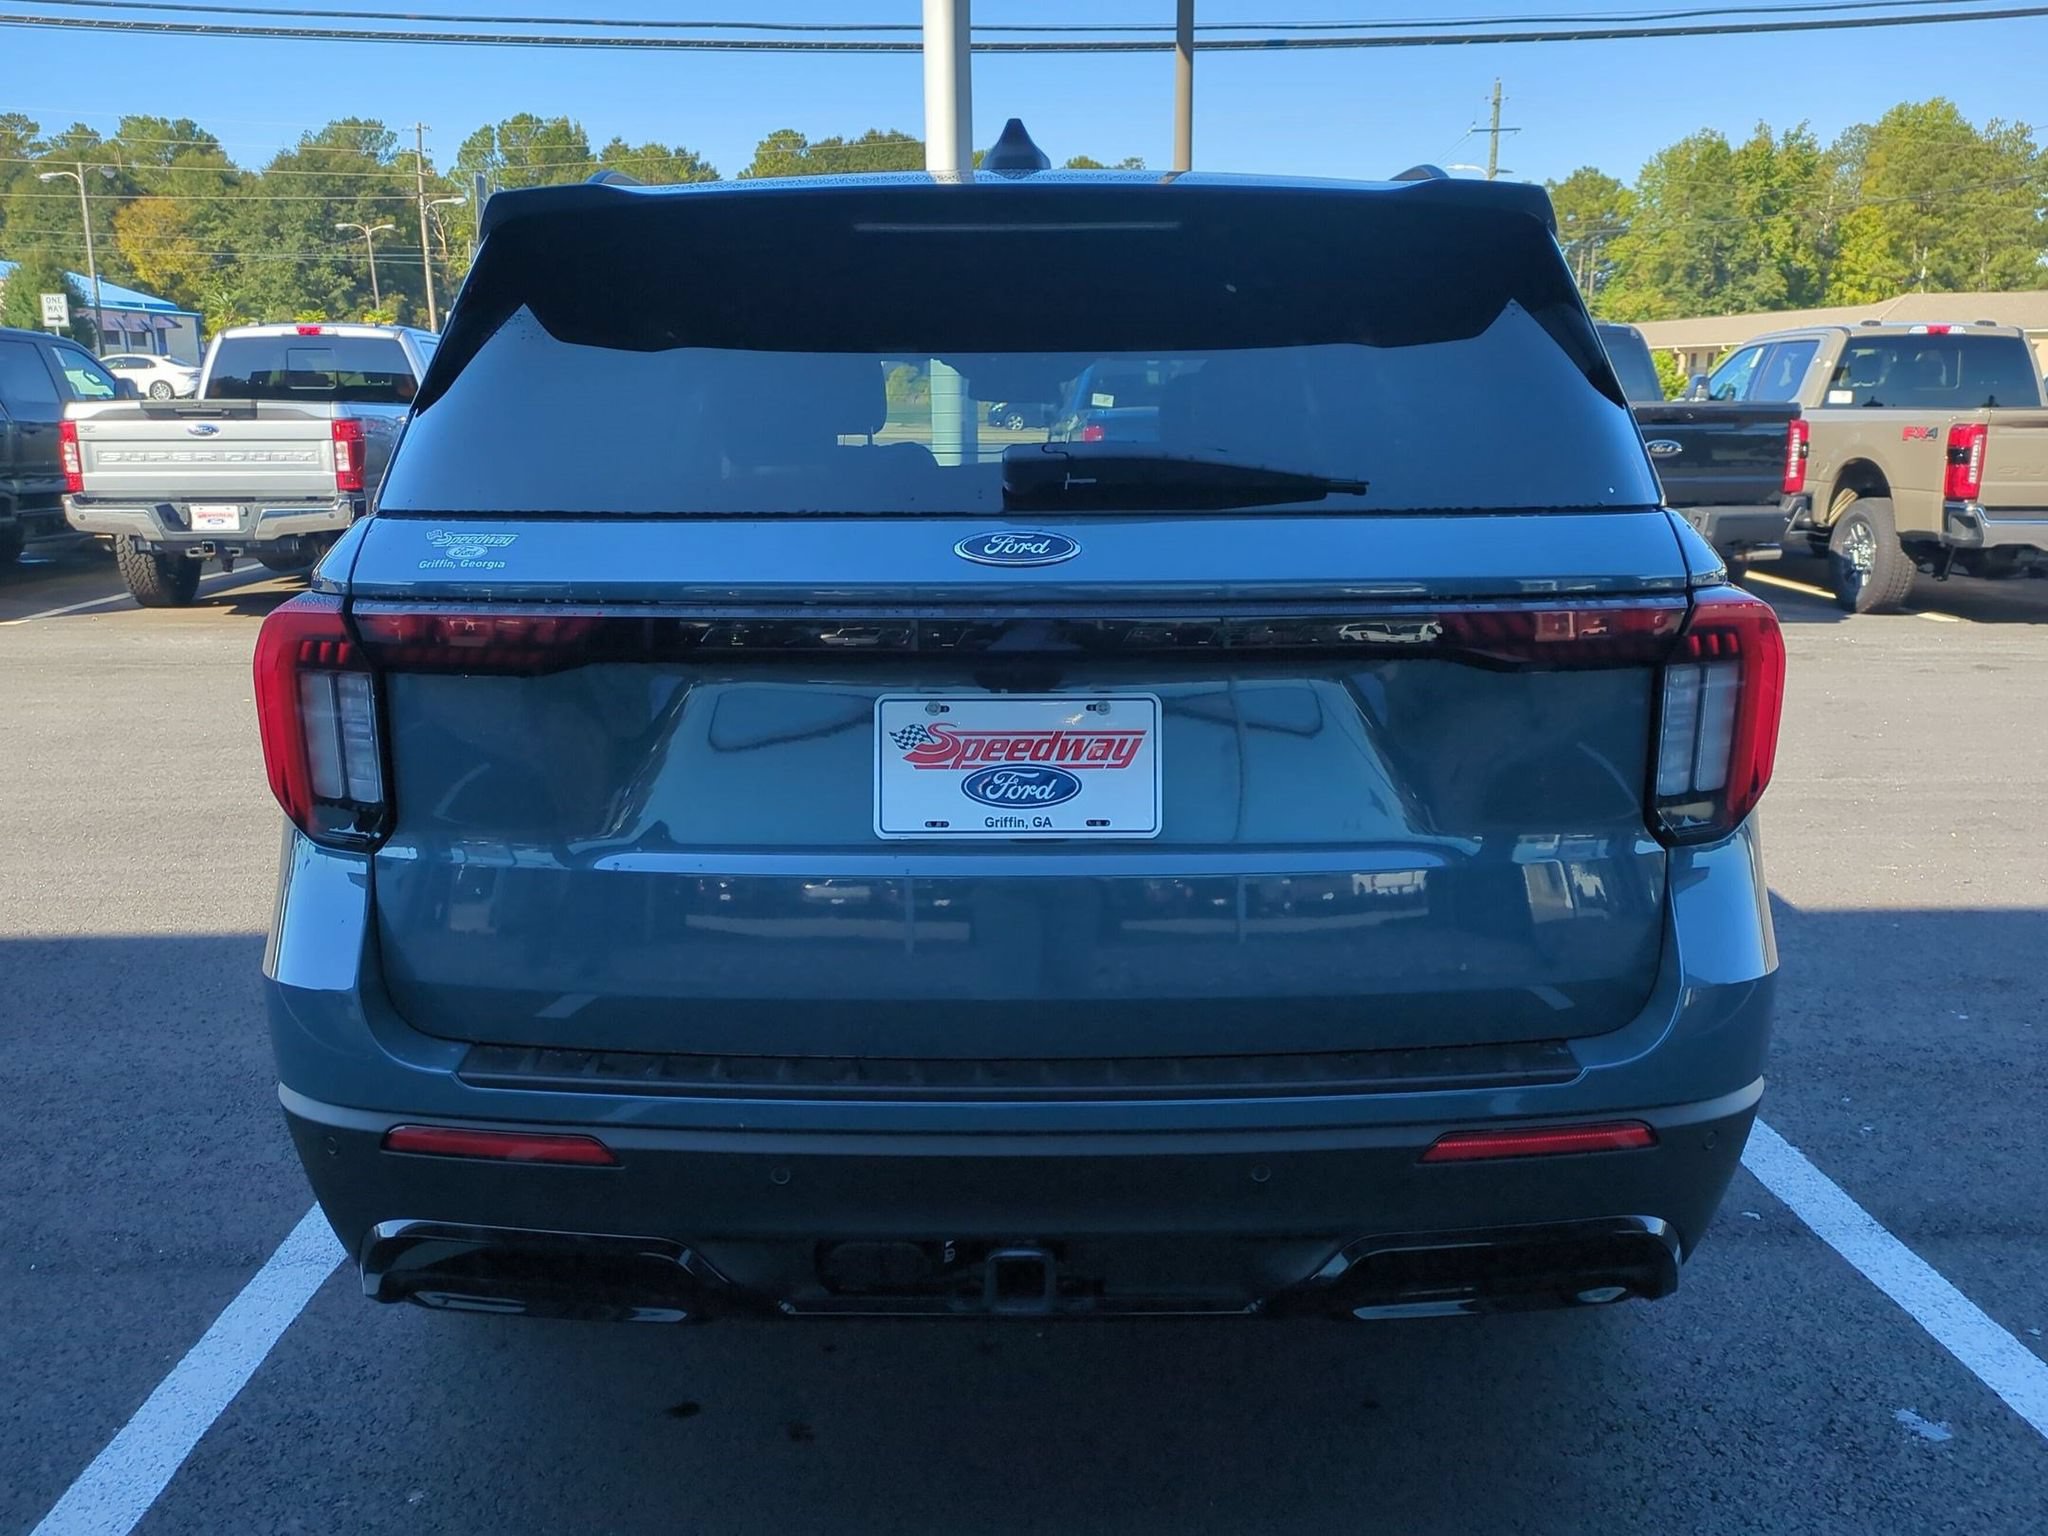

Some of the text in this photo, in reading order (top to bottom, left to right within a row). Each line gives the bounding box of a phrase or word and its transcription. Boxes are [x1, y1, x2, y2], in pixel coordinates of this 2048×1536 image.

[45, 296, 63, 304] ONE
[47, 304, 64, 312] WAY
[1902, 426, 1938, 441] FX4
[100, 451, 315, 462] SUPER DUTY
[431, 531, 519, 547] Speedway
[984, 534, 1051, 554] Ford
[419, 559, 505, 570] Griffin, Georgia
[902, 723, 1147, 770] Speedway
[985, 771, 1057, 801] Ford
[984, 816, 1053, 829] Griffin, GA
